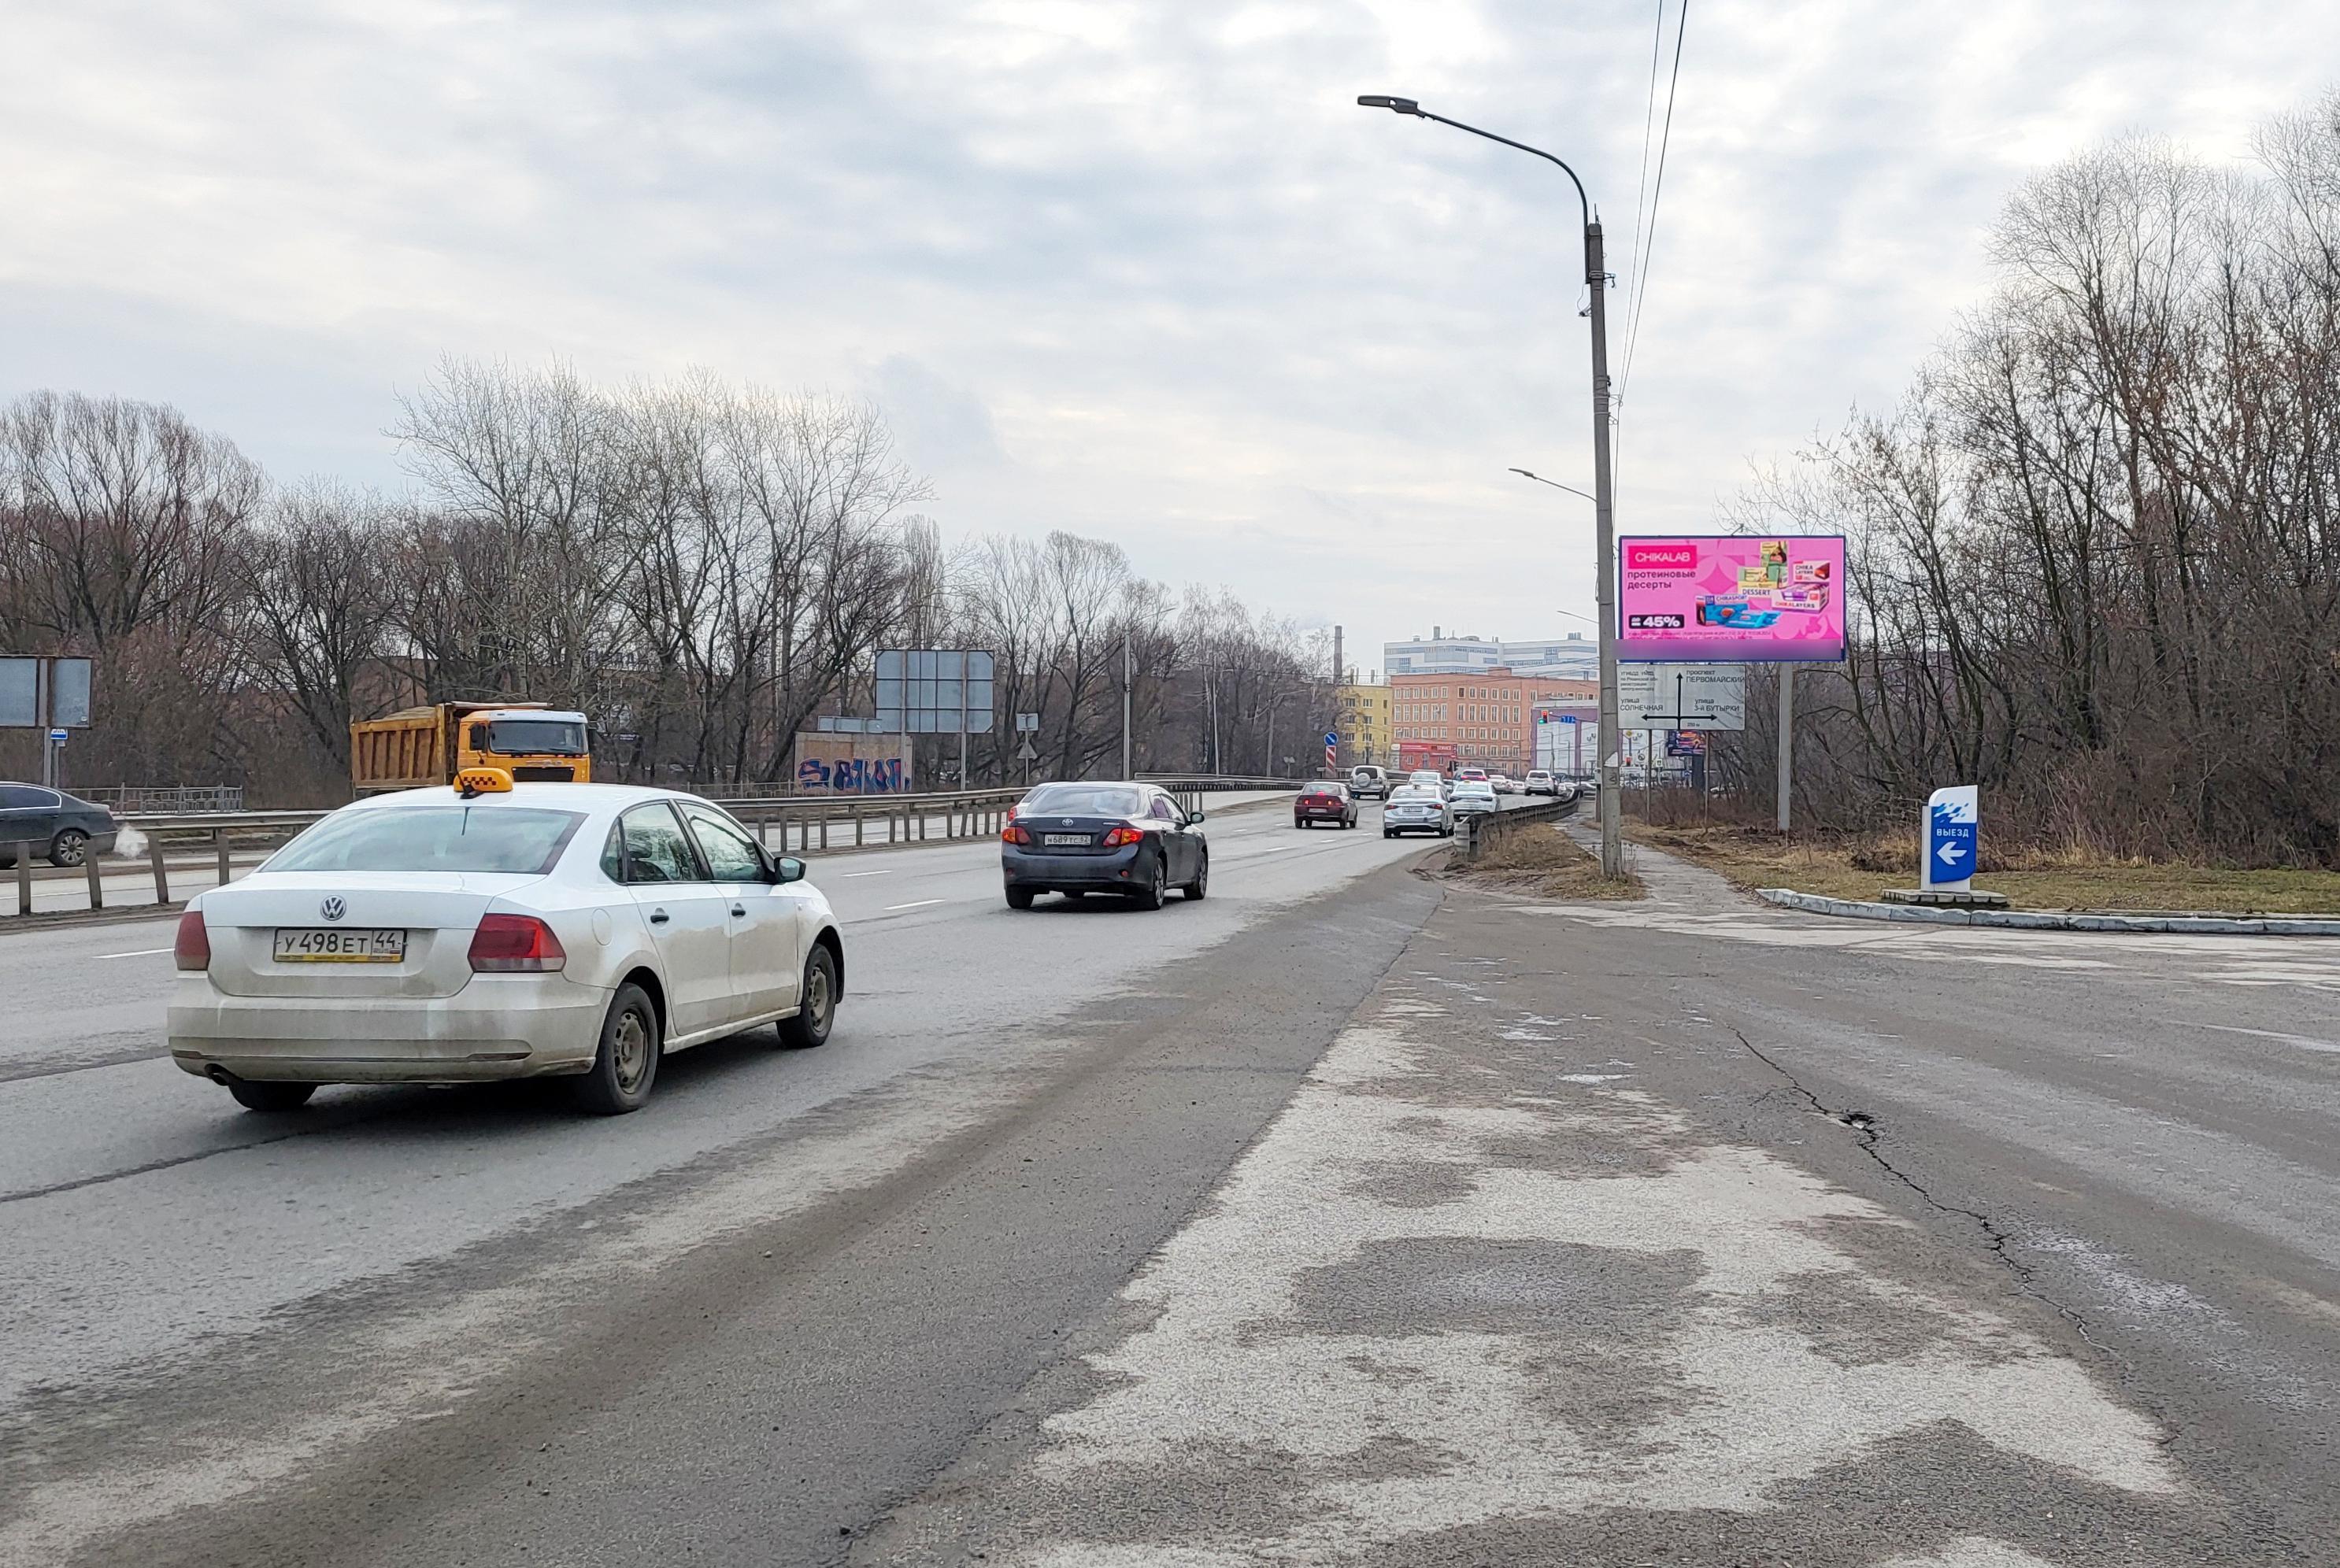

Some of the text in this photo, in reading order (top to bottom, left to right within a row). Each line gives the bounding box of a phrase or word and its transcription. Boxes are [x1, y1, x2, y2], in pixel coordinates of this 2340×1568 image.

[1635, 552, 1690, 562] CHIKALAB
[1627, 582, 1672, 590] десерты
[1936, 828, 1969, 838] ВЫЕЗД
